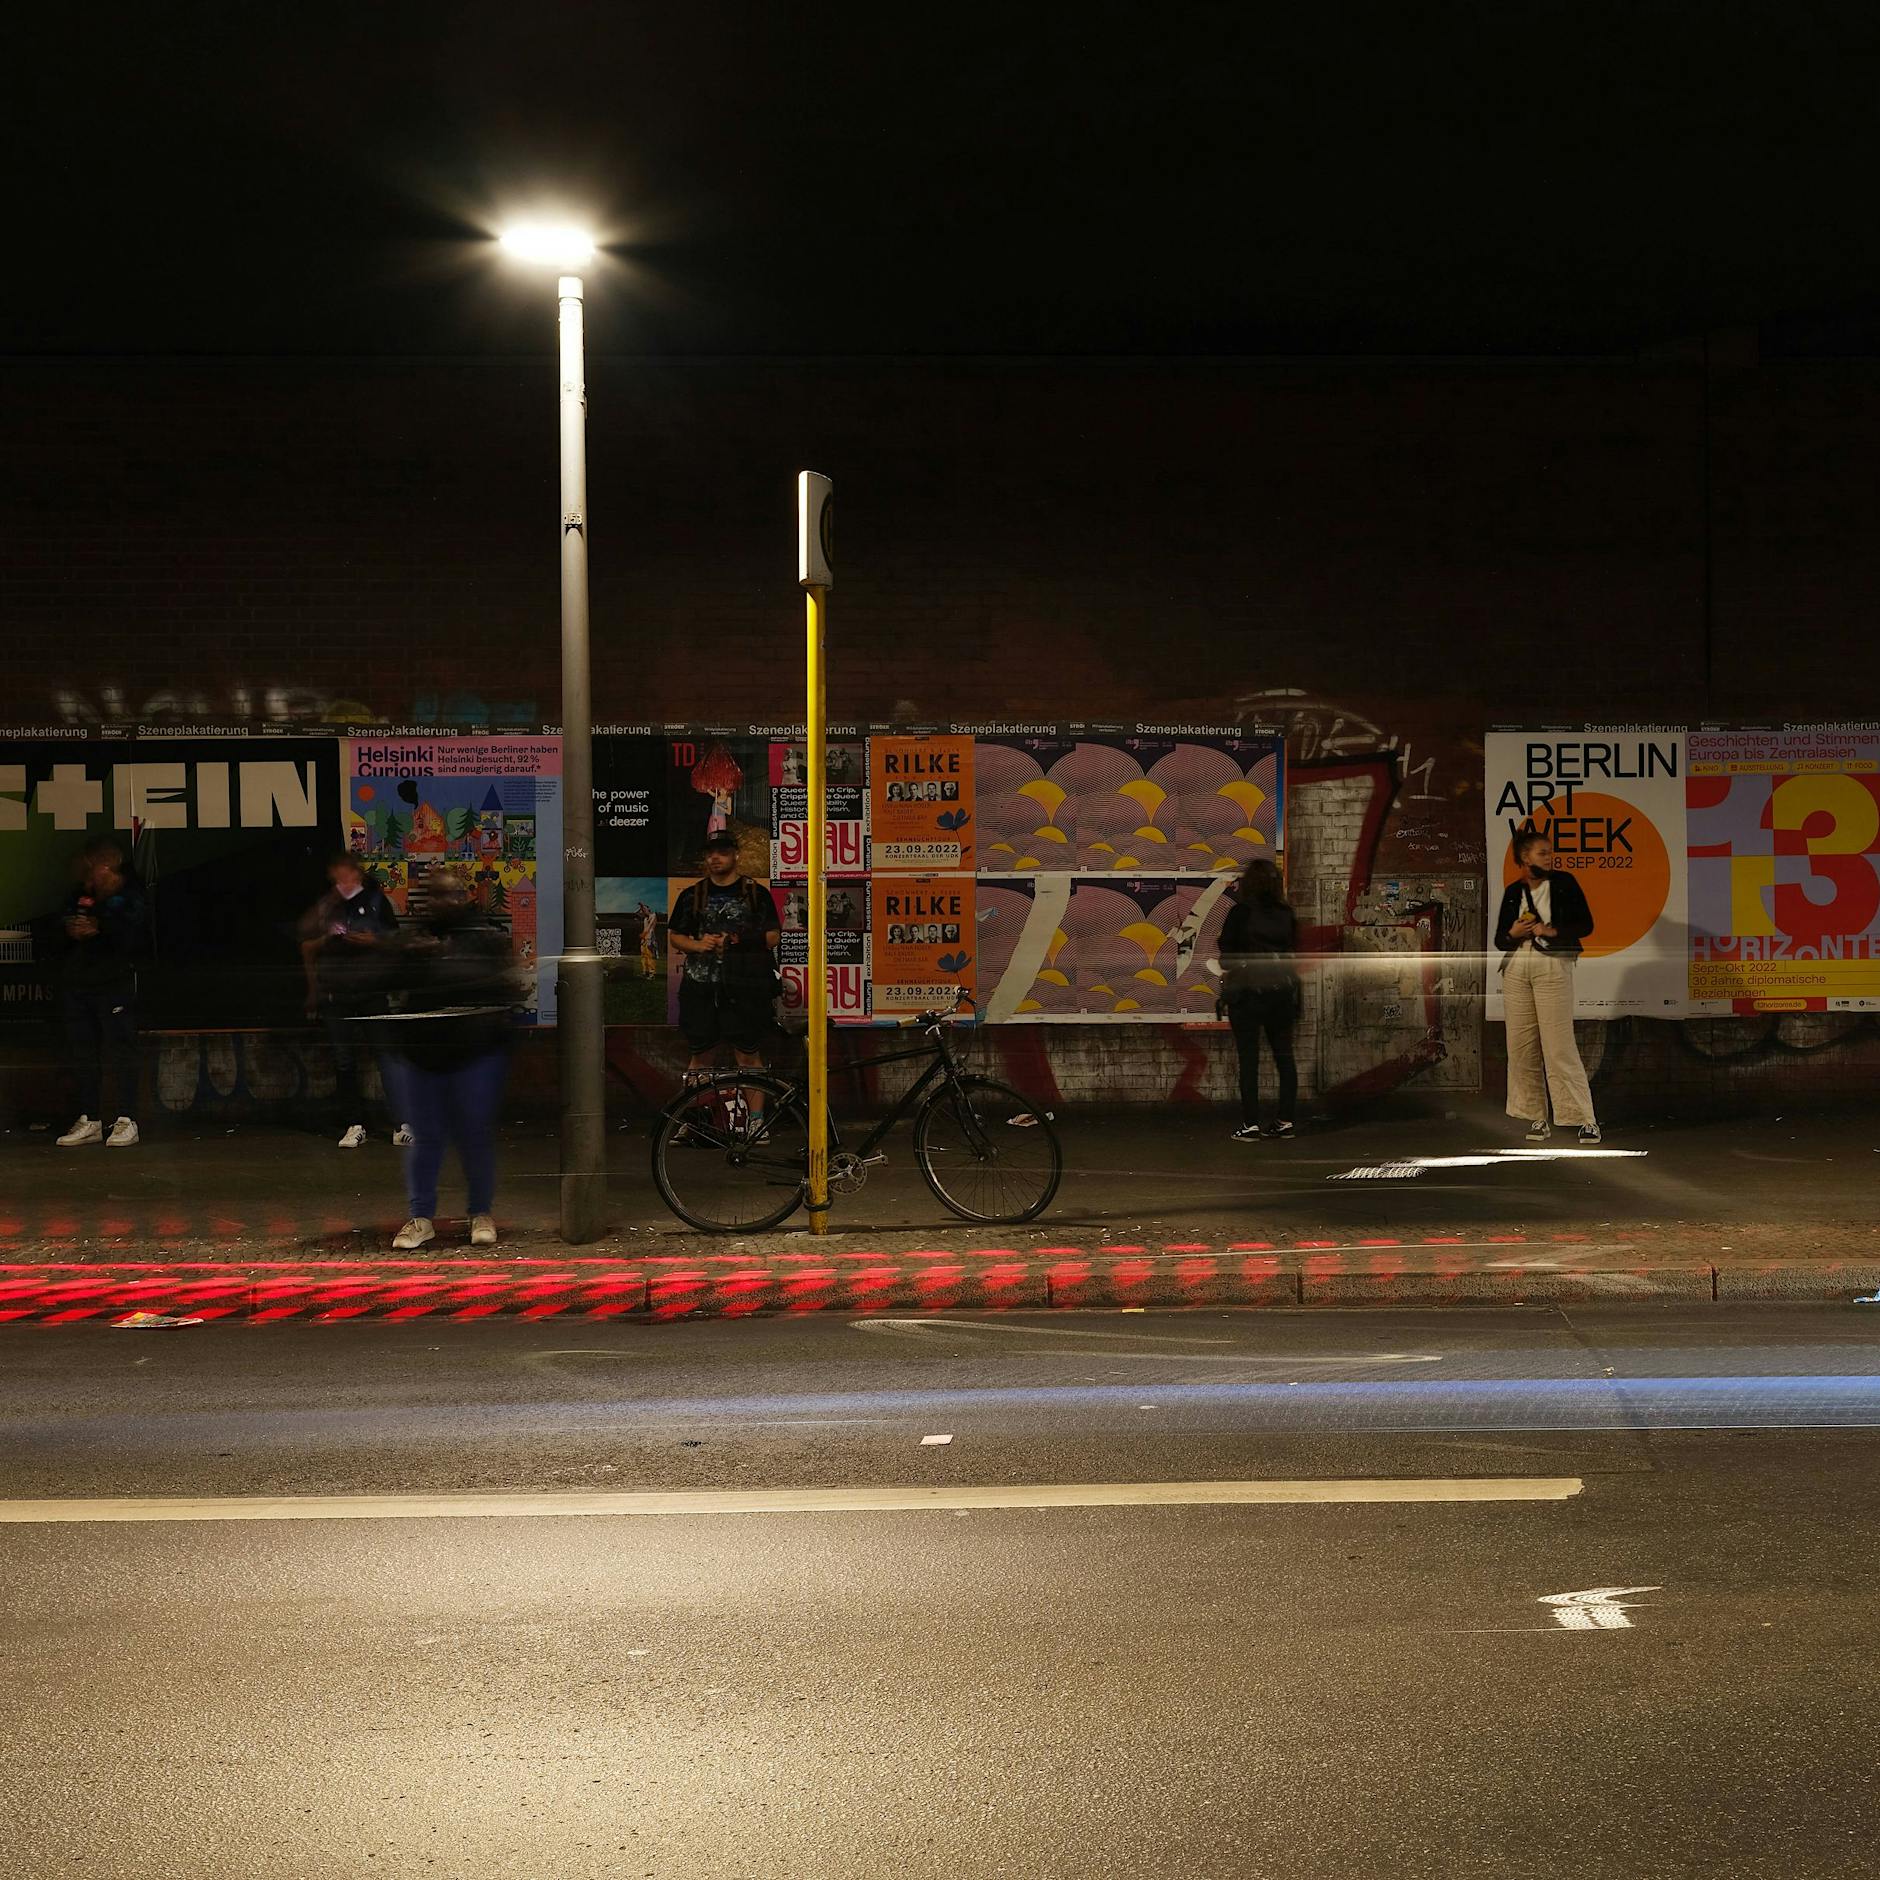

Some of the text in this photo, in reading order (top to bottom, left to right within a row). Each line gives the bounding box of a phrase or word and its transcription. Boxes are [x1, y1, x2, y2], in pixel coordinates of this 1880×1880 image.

[138, 725, 249, 737] Szeneplakatierung
[347, 726, 458, 738] Szeneplakatierung
[949, 723, 1057, 736] Szeneplakatierung
[1135, 722, 1242, 737] Szeneplakatierung
[1688, 732, 1880, 748] Geschichten und Stimmen
[358, 746, 433, 763] Helsinki
[437, 745, 558, 756] Nur wenige Berliner haben
[1688, 746, 1857, 763] Europa bis Zentralasien
[437, 755, 475, 763] Helsinki
[476, 754, 516, 764] besucht,
[885, 754, 960, 774] RILKE
[1526, 742, 1677, 779] BERLIN
[358, 763, 434, 777] Curious
[437, 764, 457, 773] sind
[459, 764, 502, 775] neugierig
[611, 790, 649, 802] power
[1495, 780, 1584, 816] ART
[598, 802, 649, 813] of music
[609, 815, 649, 827] deezer
[885, 844, 958, 854] 23.09.2022
[1566, 856, 1596, 869] SEP
[1598, 856, 1633, 869] 2022
[886, 896, 961, 916] RILKE
[1692, 963, 1777, 975] Sept-Okt 2022
[1692, 975, 1827, 987] 30 Jahre diplomatische
[1692, 988, 1766, 999] Beziehungen
